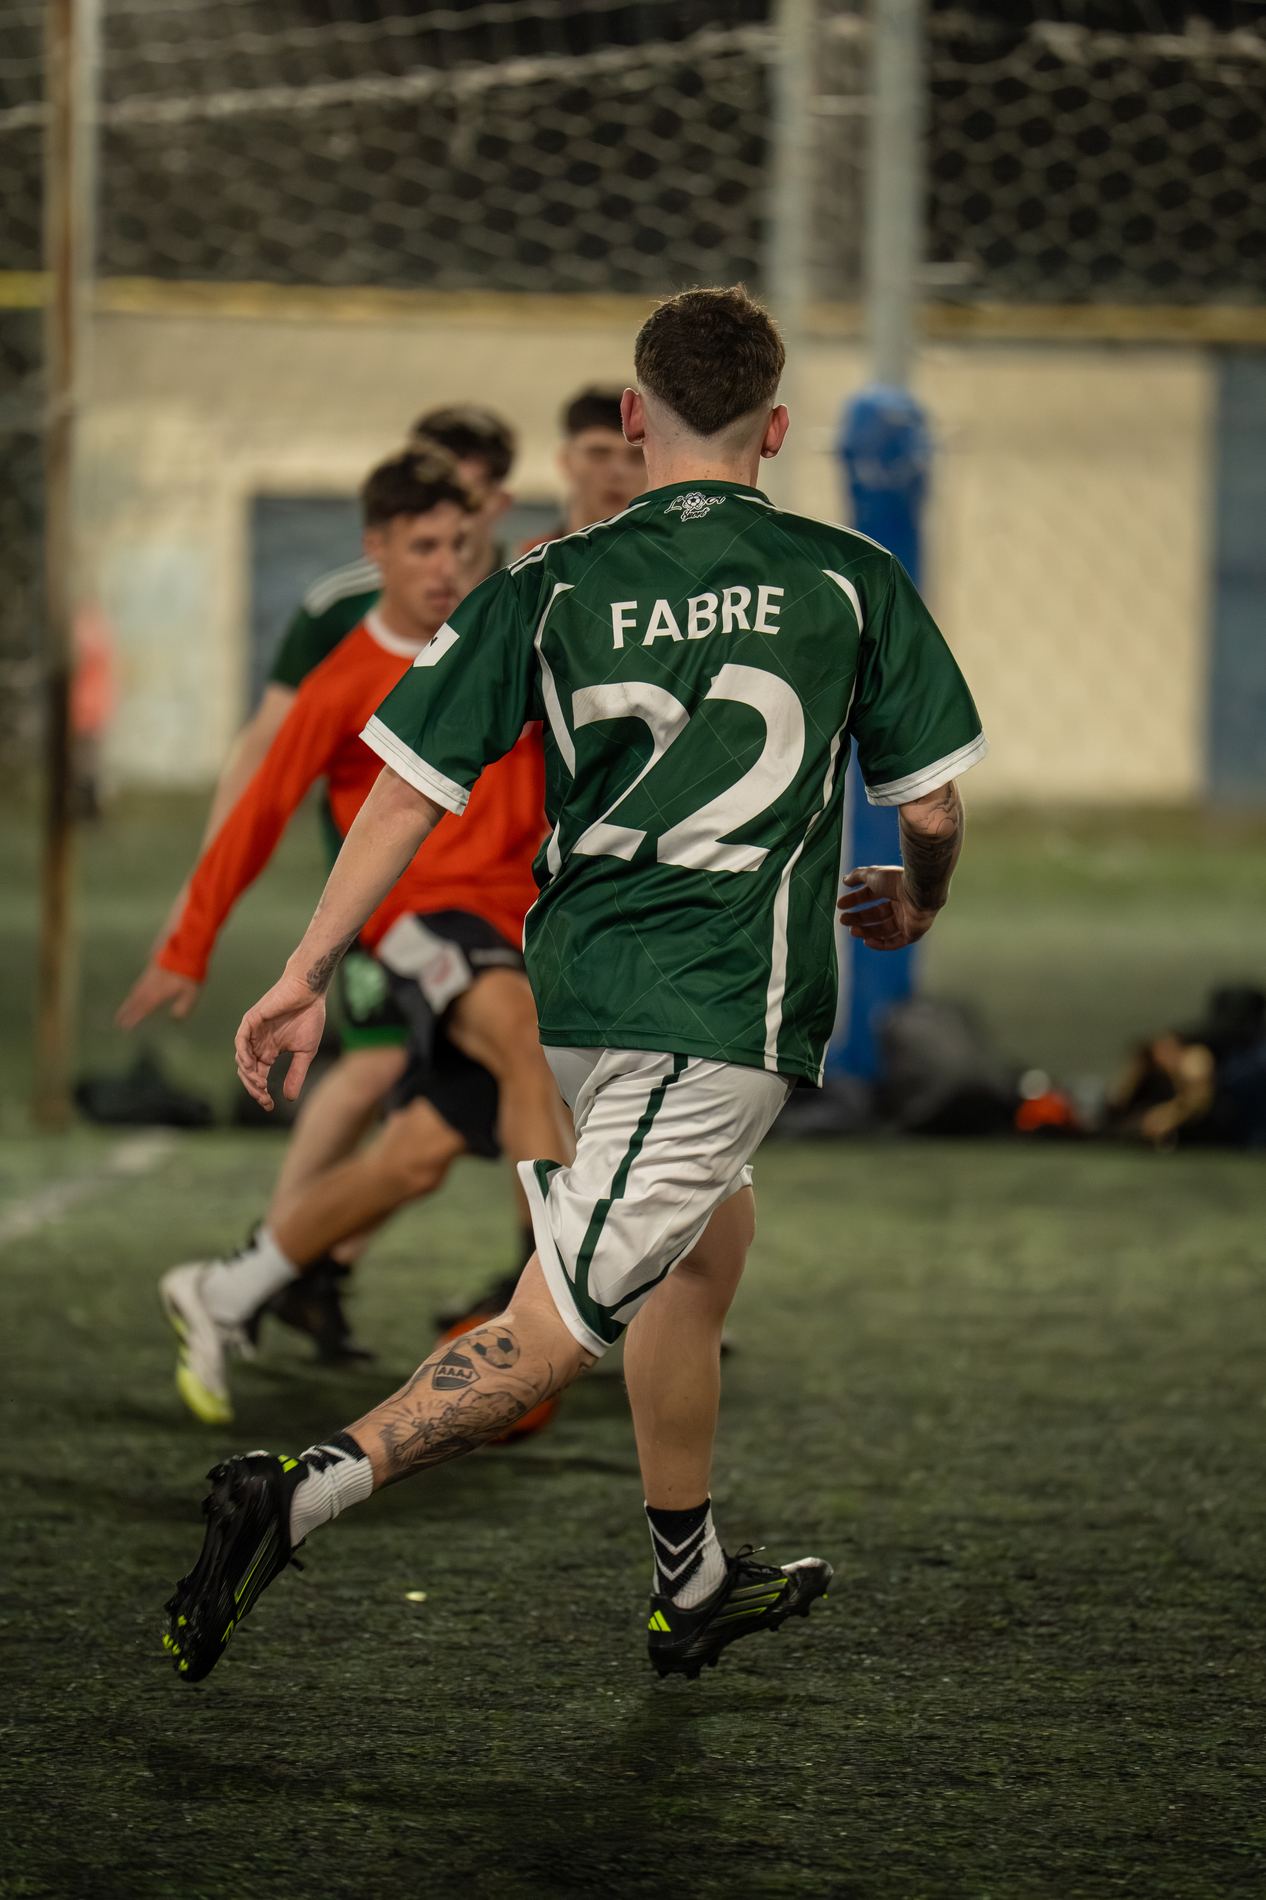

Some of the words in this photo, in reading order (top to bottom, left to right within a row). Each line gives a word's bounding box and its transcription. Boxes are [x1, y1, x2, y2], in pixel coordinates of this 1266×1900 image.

[610, 585, 785, 650] FABRE
[572, 663, 806, 872] 22
[438, 1366, 473, 1379] AAAJ
